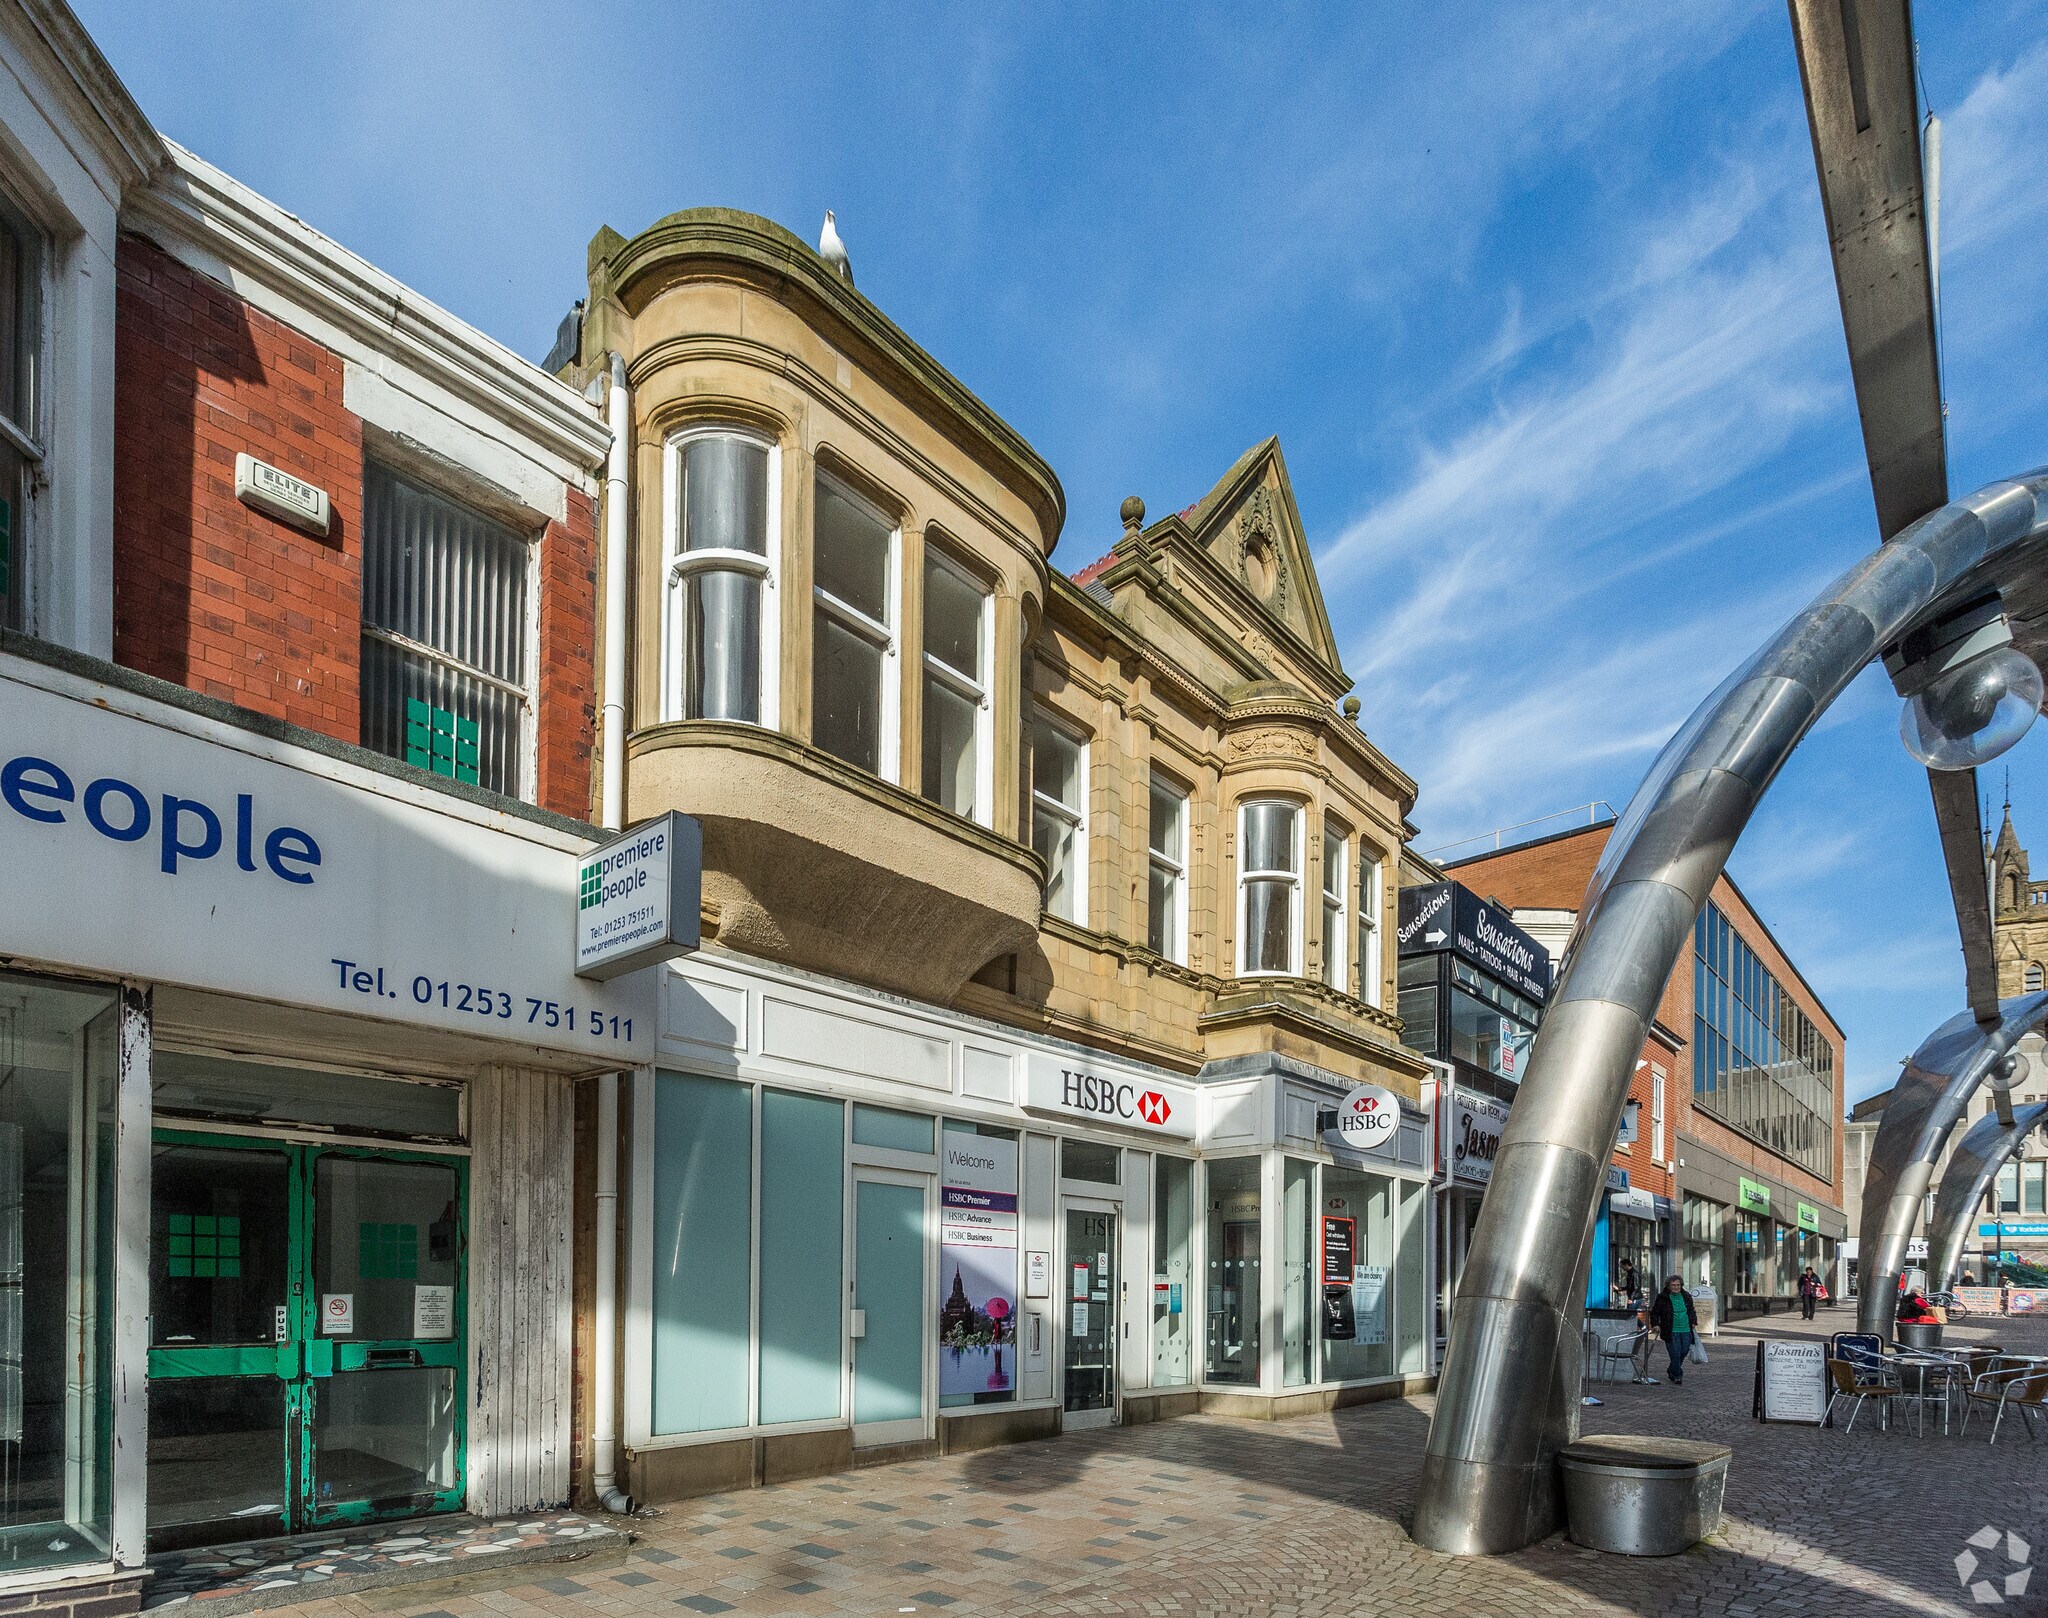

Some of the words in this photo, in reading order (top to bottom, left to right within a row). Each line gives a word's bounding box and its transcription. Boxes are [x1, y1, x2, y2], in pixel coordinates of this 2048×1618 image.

[263, 468, 311, 500] ELITE
[602, 834, 664, 881] premiere
[602, 868, 647, 908] people
[590, 927, 602, 940] Tel:
[604, 914, 626, 934] 01253
[628, 905, 654, 926] 751511
[1397, 889, 1450, 943] Sensations
[581, 919, 664, 957] www.premierepeople.com
[1476, 908, 1534, 972] Sensations
[1458, 932, 1474, 954] NAILS
[1480, 946, 1502, 972] TATTOOS
[1506, 965, 1518, 982] HAIR
[1524, 978, 1544, 998] SUNBEDS
[331, 958, 396, 999] Tel.
[412, 976, 512, 1019] 01253
[525, 997, 575, 1031] 751
[590, 1010, 632, 1042] 511
[1061, 1069, 1134, 1119] HSBC
[1342, 1113, 1391, 1131] HSBC
[1455, 1113, 1502, 1161] Jasm
[948, 1150, 995, 1170] Welcome
[948, 1192, 967, 1204] HSBC
[968, 1194, 991, 1206] Premier
[948, 1212, 967, 1222] HSBC
[967, 1214, 992, 1224] Advance
[948, 1230, 966, 1240] HSBC
[966, 1232, 992, 1242] Business
[1767, 1344, 1821, 1358] Jasmin's
